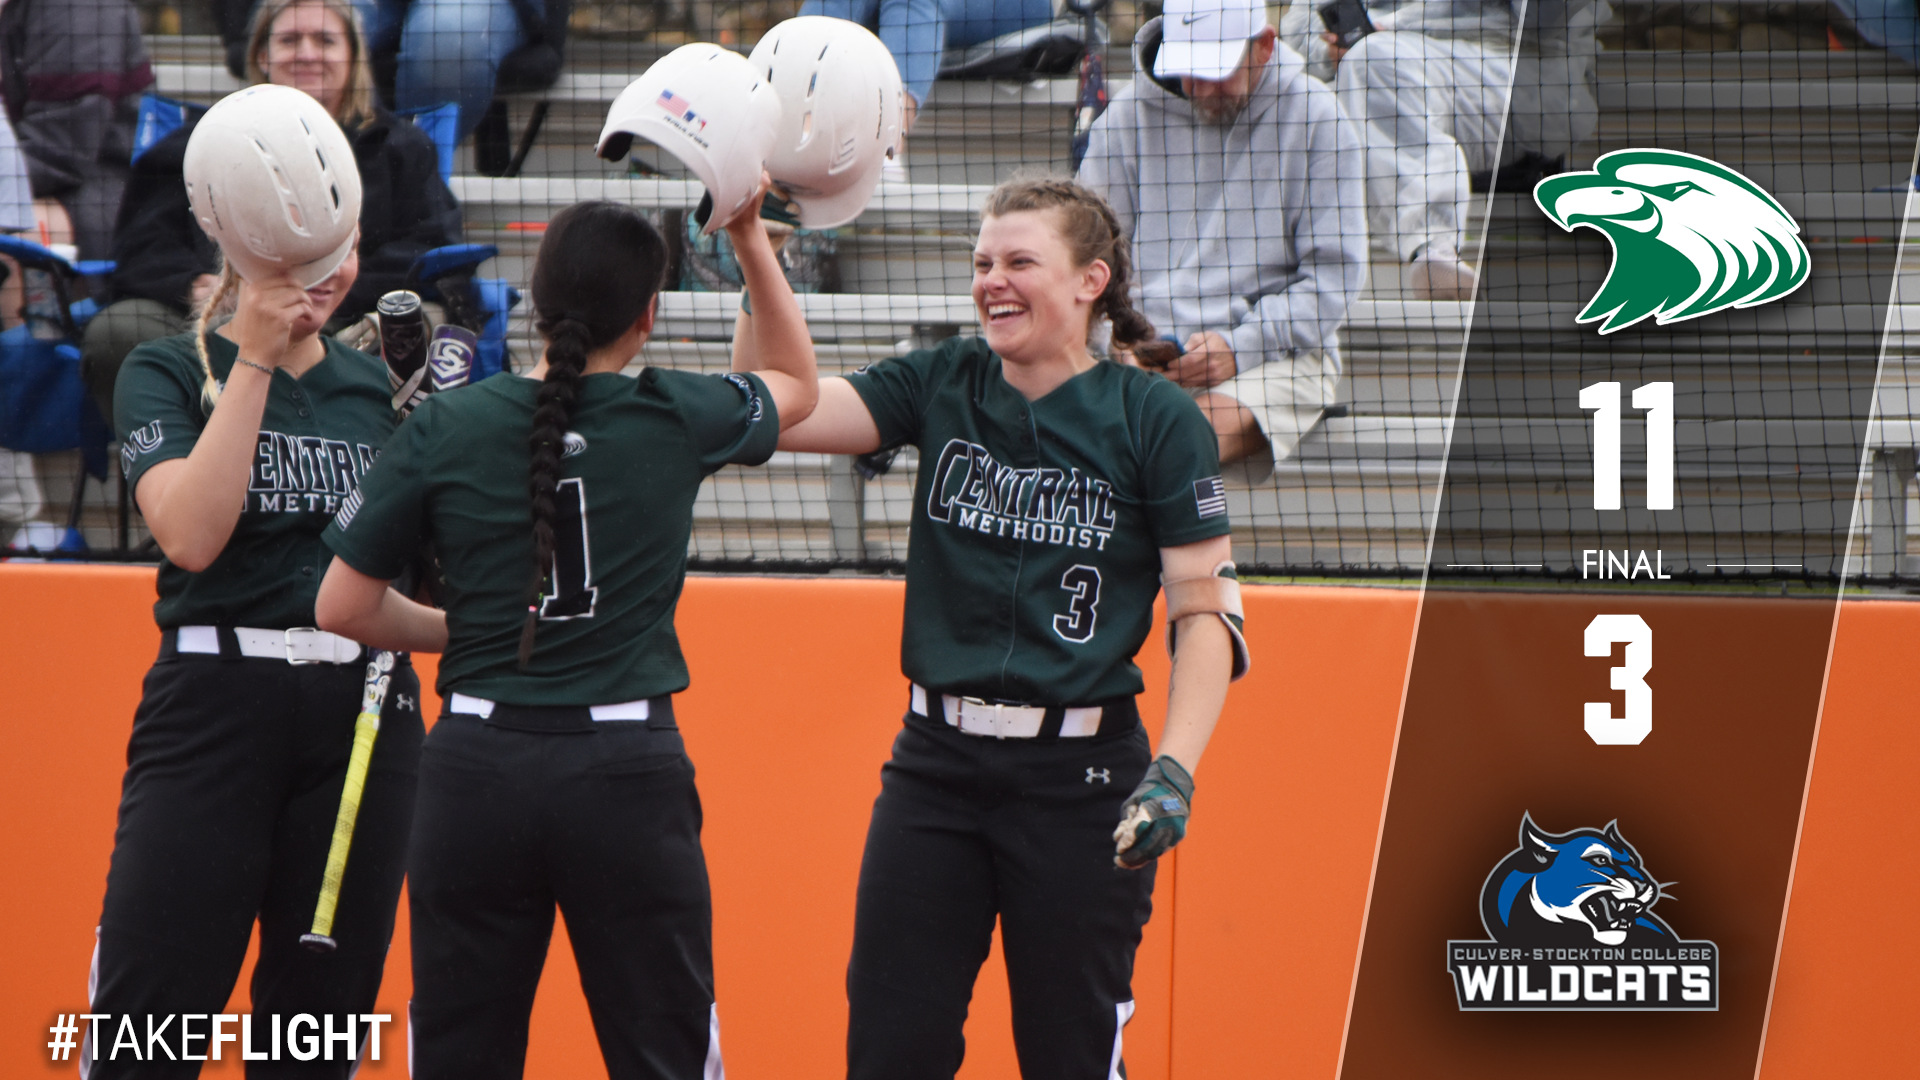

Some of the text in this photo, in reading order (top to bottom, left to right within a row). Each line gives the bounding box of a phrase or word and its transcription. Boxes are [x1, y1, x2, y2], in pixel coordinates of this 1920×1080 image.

[927, 437, 1116, 531] CENTRAL
[540, 477, 598, 620] 1
[957, 507, 1111, 551] METHODIST
[1052, 563, 1102, 644] 3
